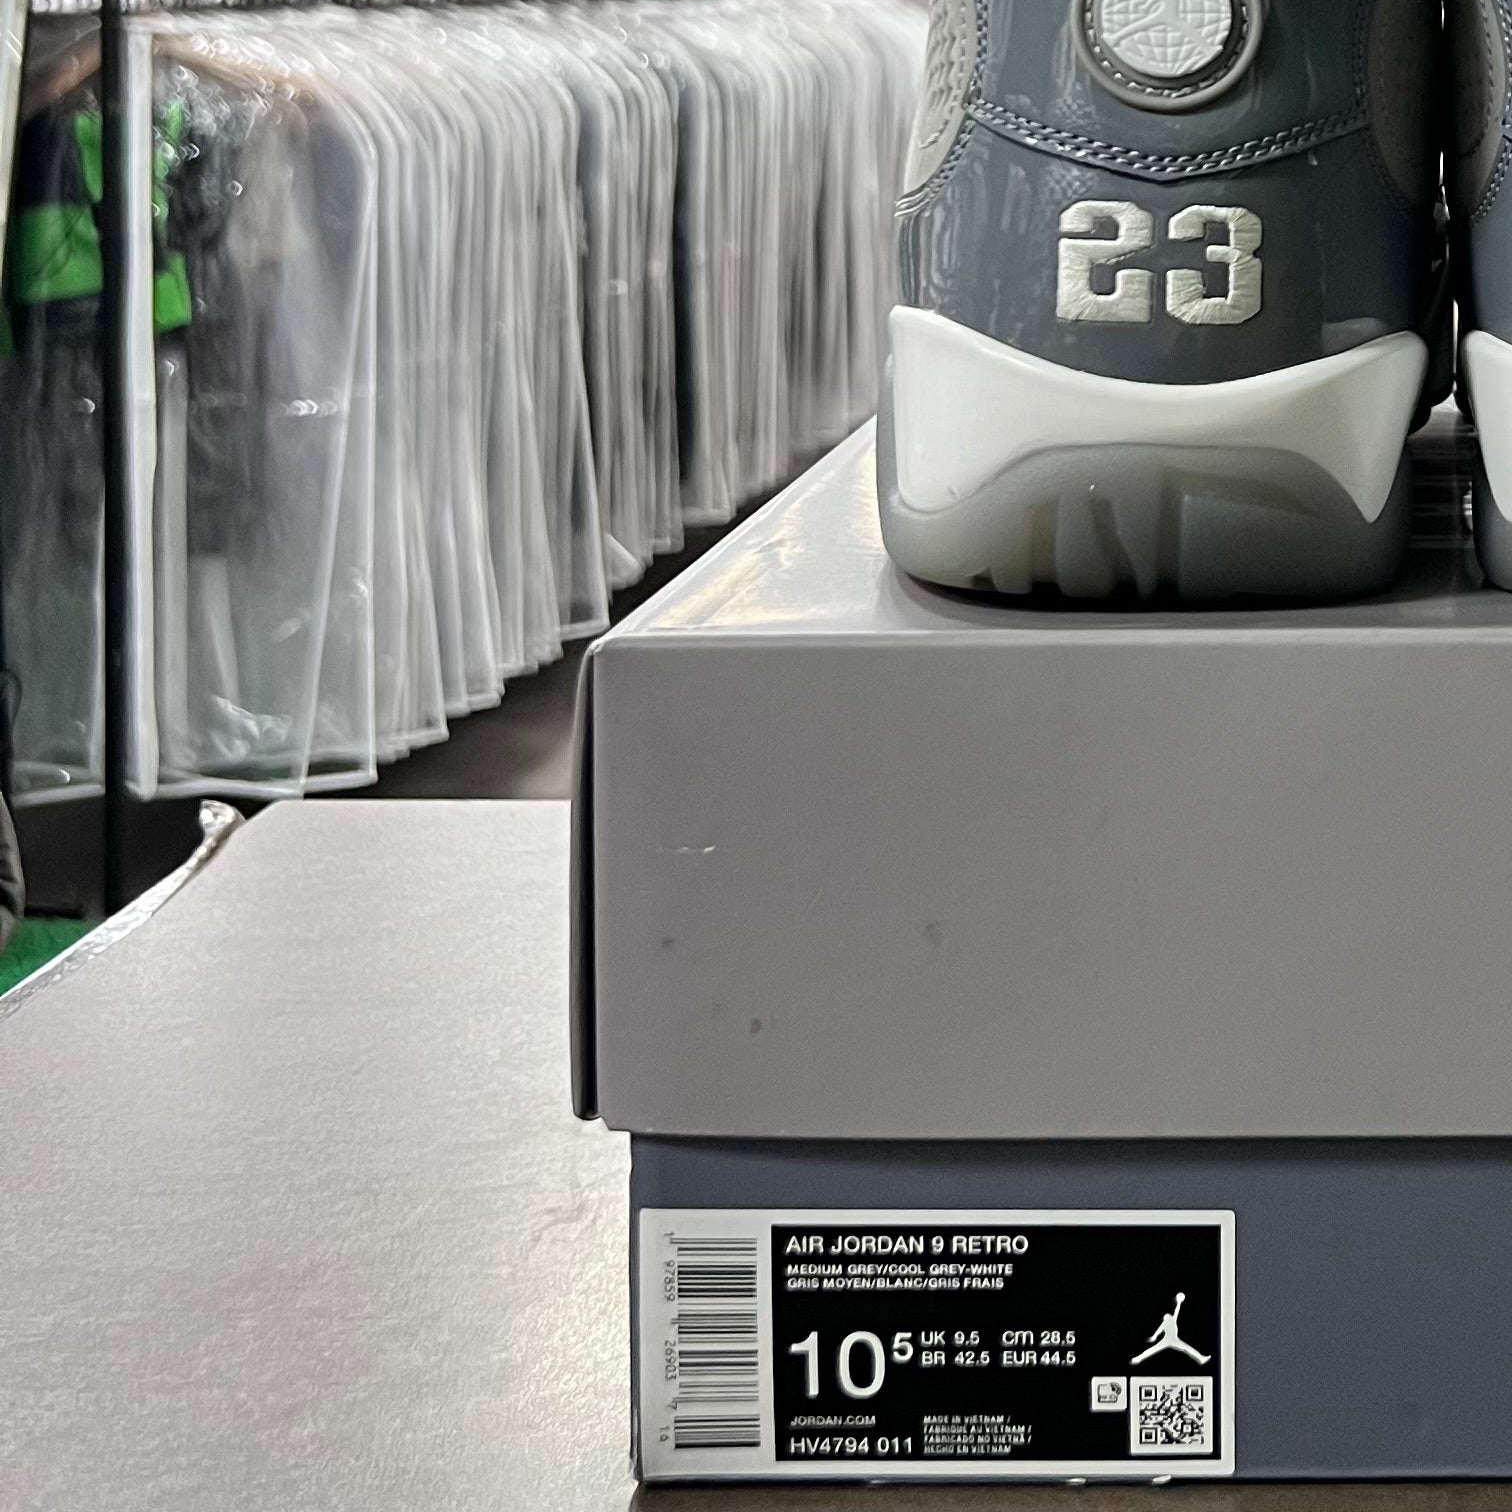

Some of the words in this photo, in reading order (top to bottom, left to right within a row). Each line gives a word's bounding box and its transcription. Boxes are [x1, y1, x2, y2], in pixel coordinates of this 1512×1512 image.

[1056, 200, 1263, 324] 23
[786, 1235, 824, 1254] AIR
[830, 1235, 924, 1255] JORDAN
[932, 1235, 945, 1254] 9
[952, 1235, 1029, 1254] RETRO
[787, 1263, 843, 1276] MEDIUM
[848, 1263, 925, 1276] GREY/COOL
[929, 1263, 1014, 1276] GREY-WHITE
[664, 1260, 675, 1301] 97859
[787, 1277, 820, 1289] GRIS
[823, 1277, 961, 1290] MOYEN/BLANC/GRIS
[964, 1277, 1005, 1289] FRAIS
[920, 1331, 946, 1345] UK
[954, 1331, 980, 1345] 9.5
[1040, 1331, 1076, 1345] 28.5
[664, 1340, 677, 1381] 26903
[921, 1351, 946, 1366] BR
[954, 1351, 990, 1366] 42.5
[1002, 1351, 1038, 1366] EUR
[1040, 1351, 1076, 1366] 44.5
[790, 1415, 876, 1427] JORDAN.COM
[923, 1415, 949, 1424] MADE
[790, 1436, 870, 1454] HV4794
[877, 1436, 913, 1454] 011
